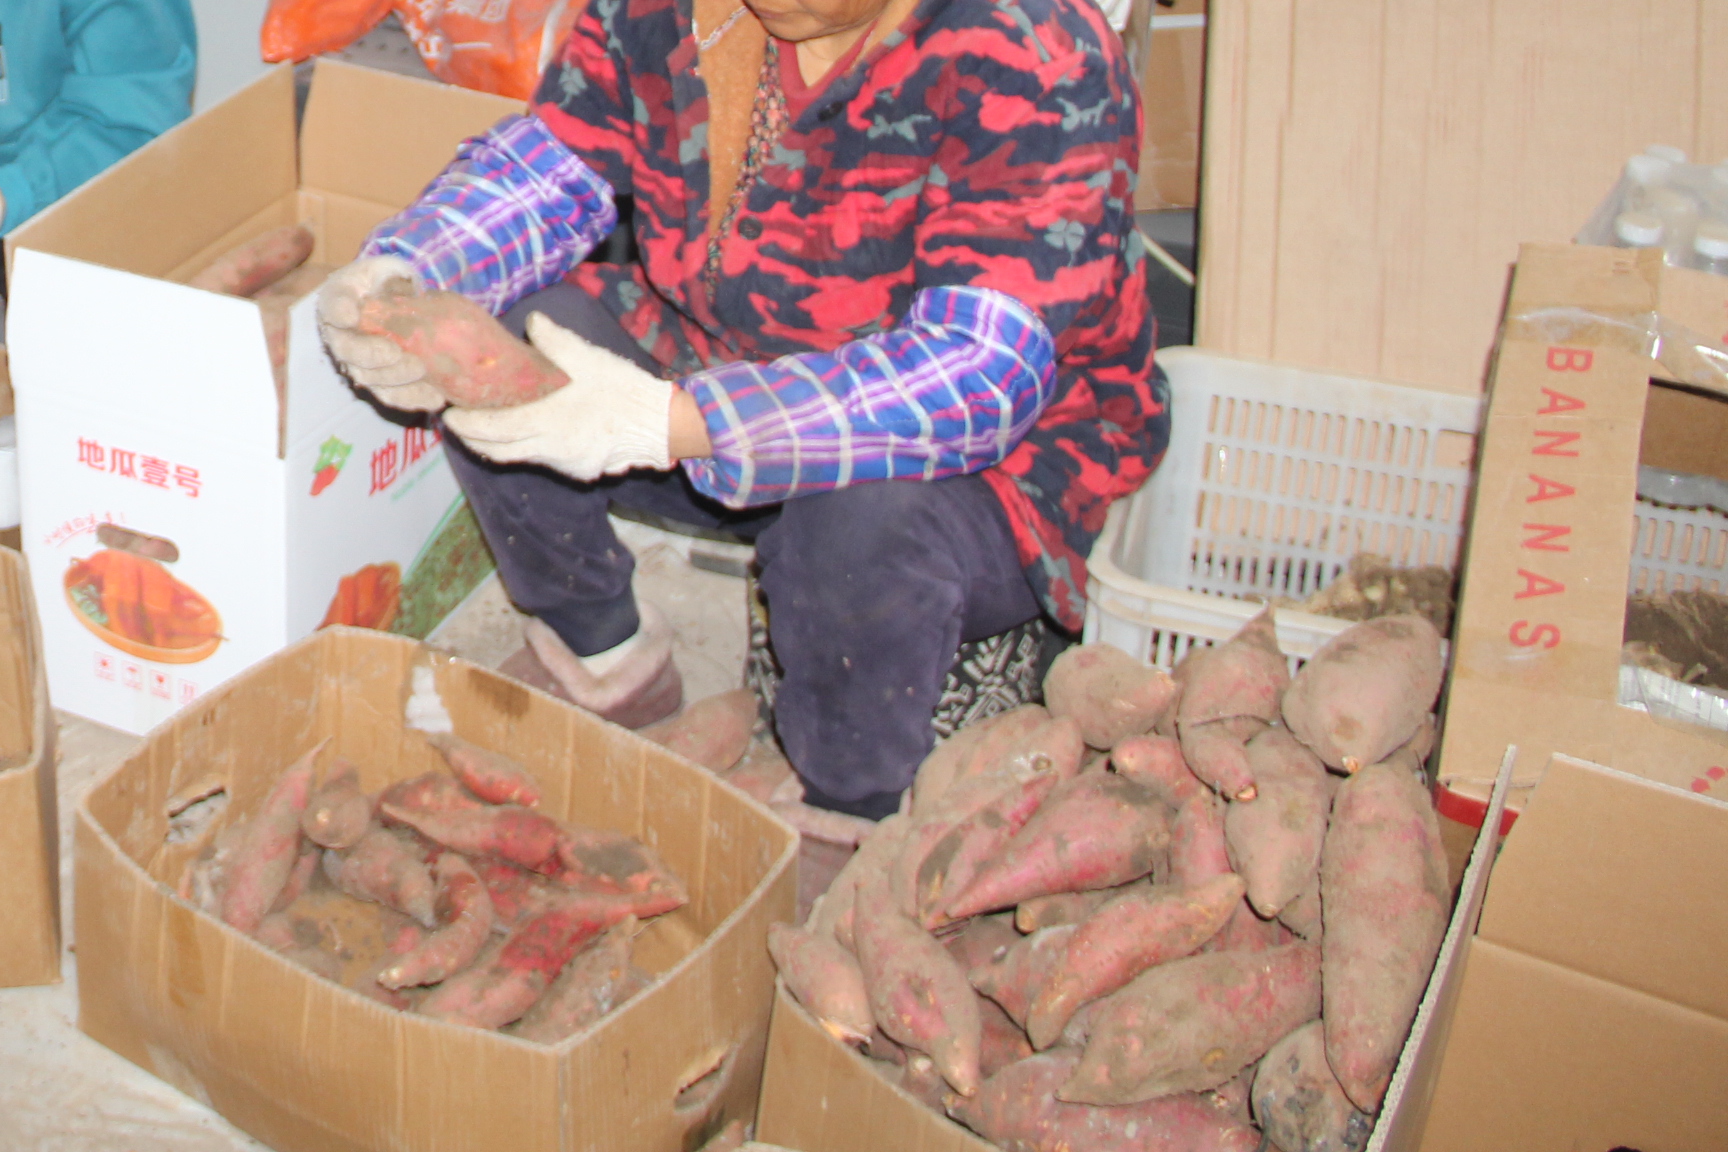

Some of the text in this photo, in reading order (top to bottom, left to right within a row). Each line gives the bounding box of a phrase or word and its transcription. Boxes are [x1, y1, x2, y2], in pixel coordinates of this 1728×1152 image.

[75, 435, 204, 500] 地瓜壹号
[1508, 346, 1595, 650] BANANAS
